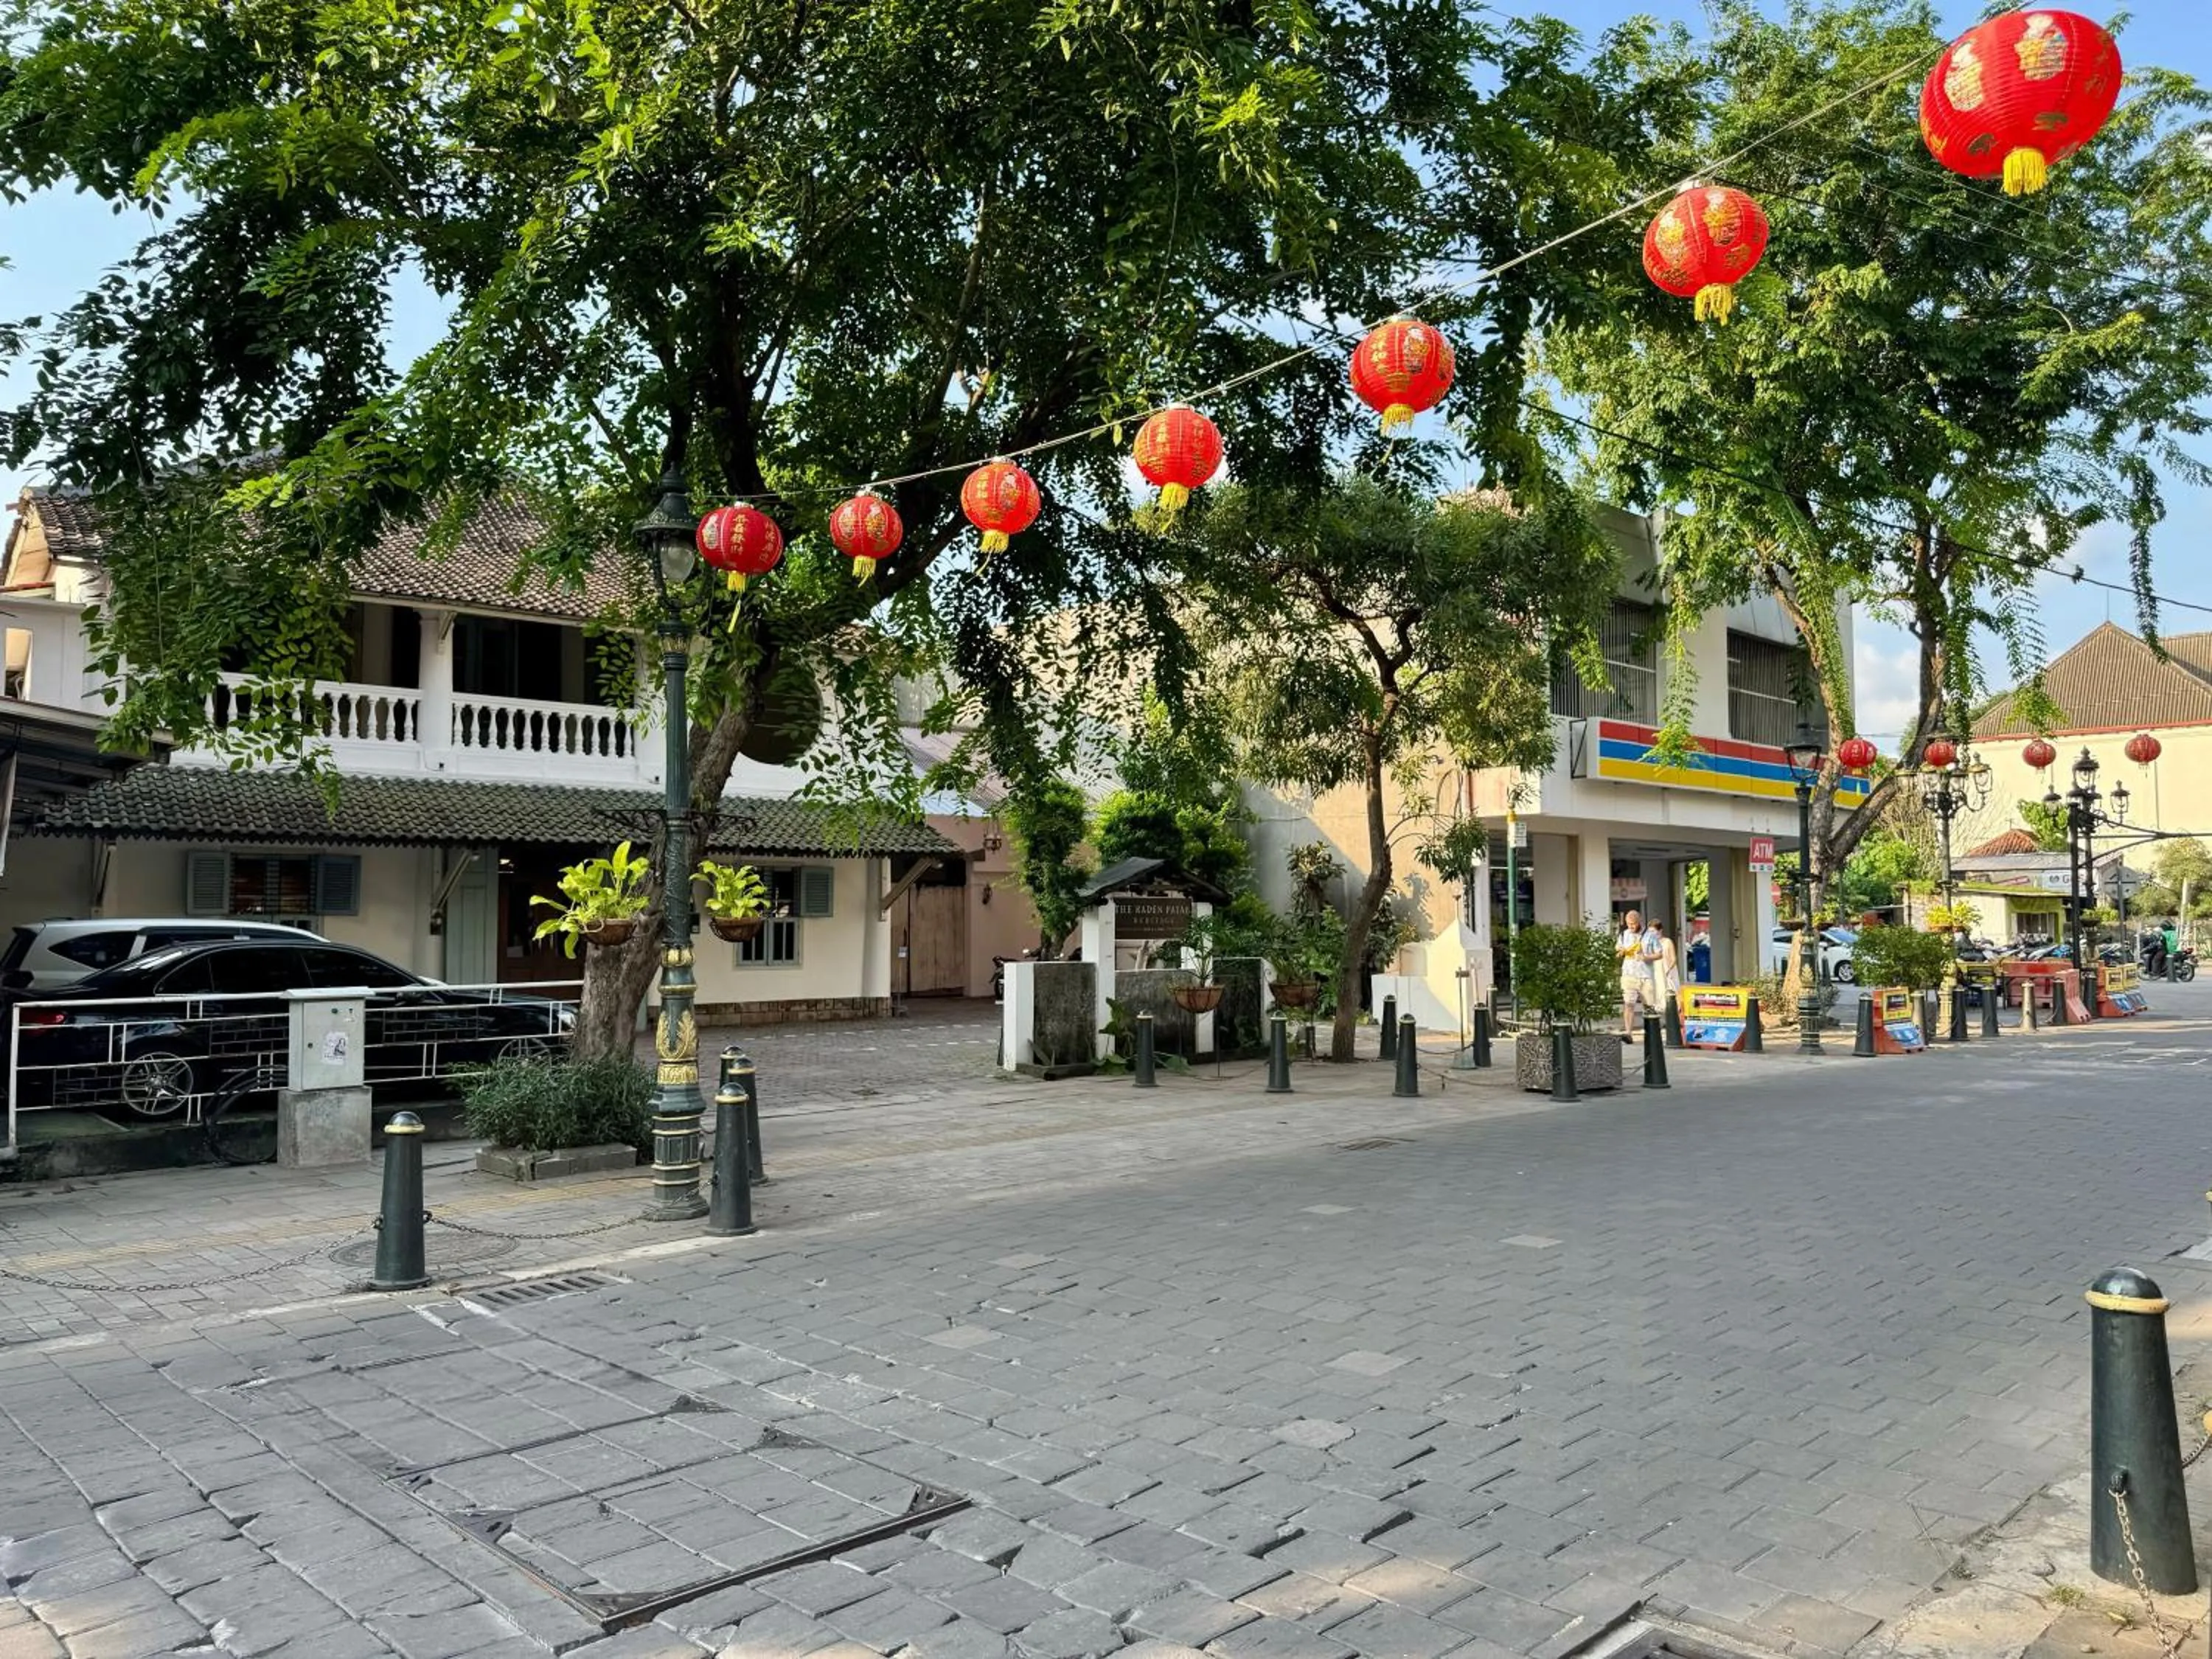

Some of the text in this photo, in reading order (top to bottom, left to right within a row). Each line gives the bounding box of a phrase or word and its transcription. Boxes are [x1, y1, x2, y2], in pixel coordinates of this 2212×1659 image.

[1753, 842, 1773, 859] ATM
[1115, 905, 1133, 914] THE
[1135, 905, 1163, 914] RADEN
